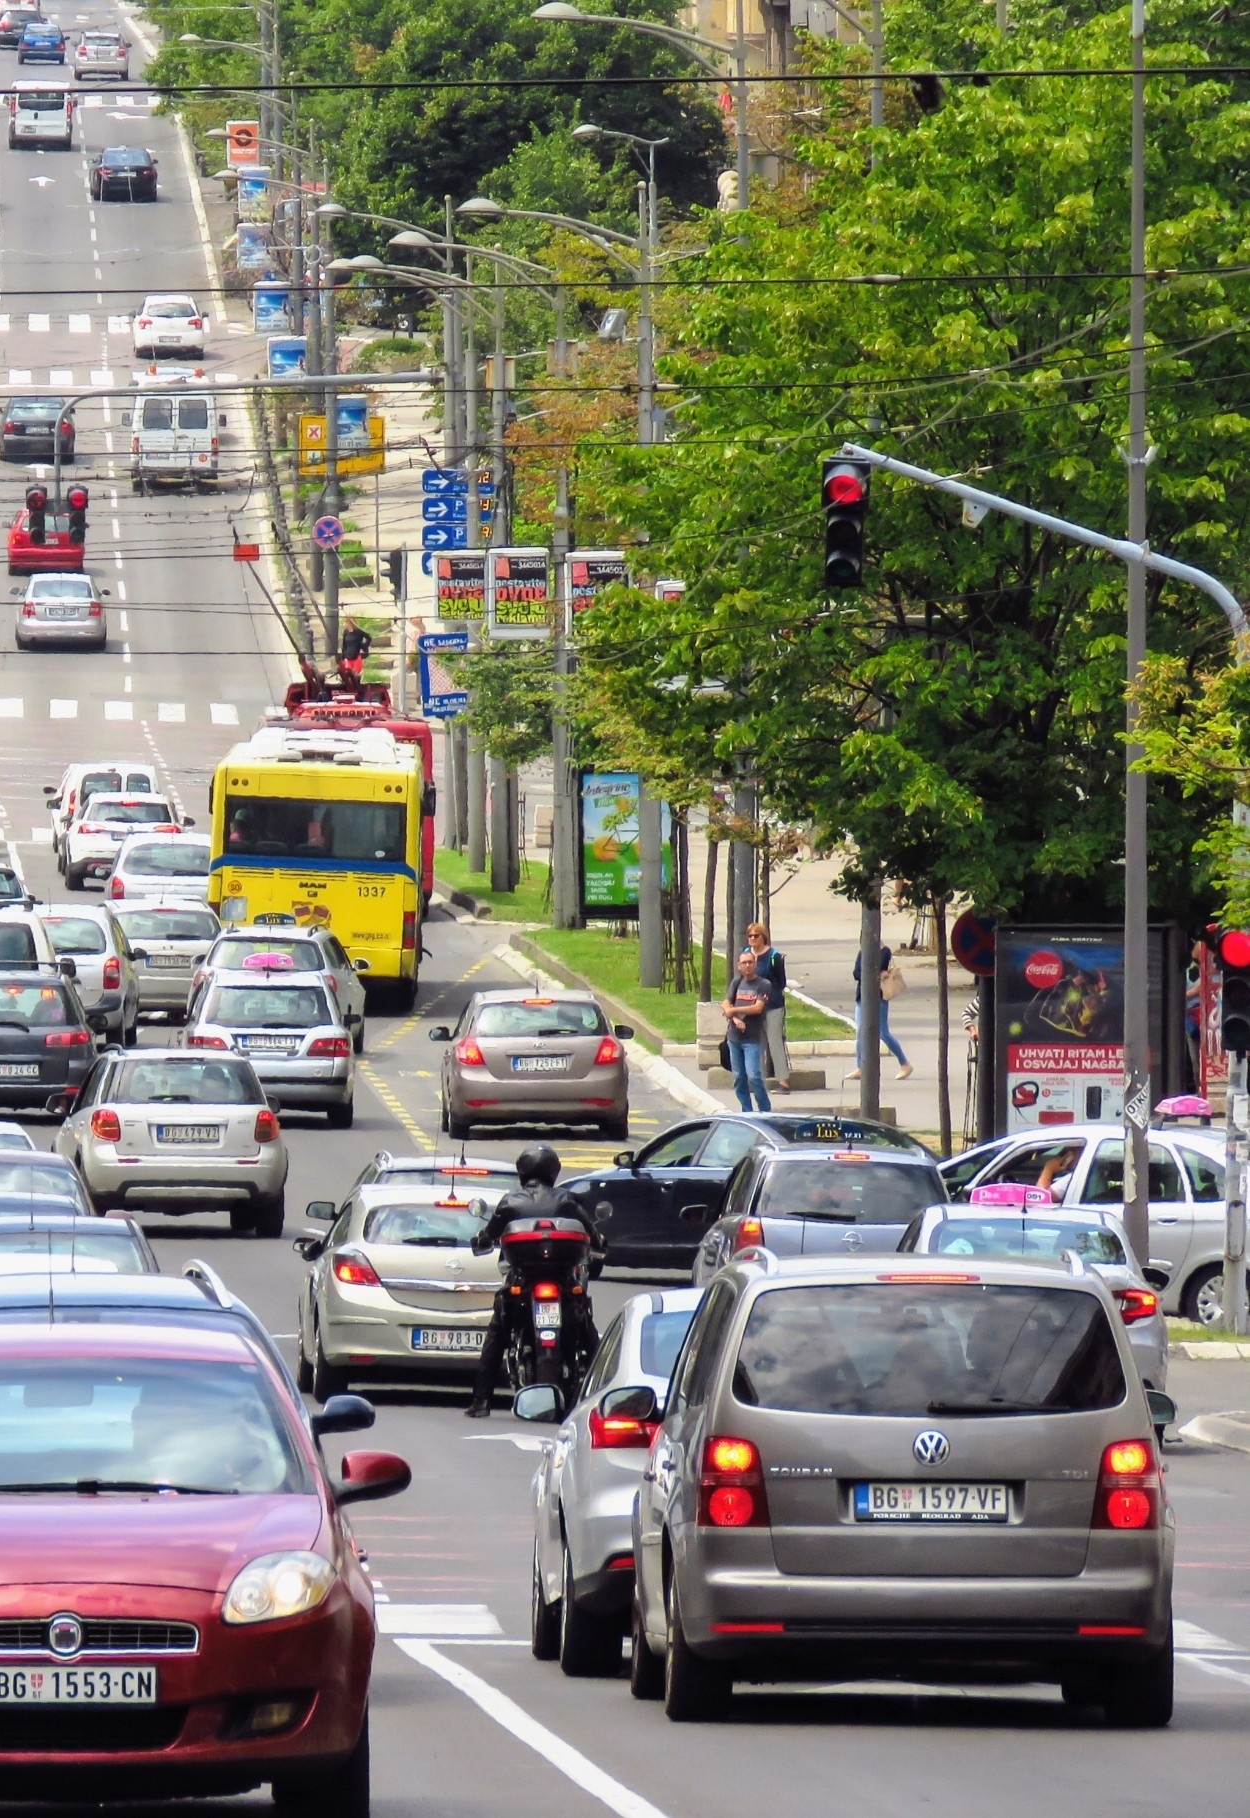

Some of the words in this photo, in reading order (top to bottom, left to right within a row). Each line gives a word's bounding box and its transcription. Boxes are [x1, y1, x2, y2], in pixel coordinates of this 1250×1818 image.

[456, 529, 464, 539] P
[357, 886, 386, 898] 1337
[1019, 1049, 1065, 1058] UHVATI
[1068, 1049, 1105, 1058] RITAM
[1109, 1049, 1124, 1058] LE
[1024, 1059, 1079, 1069] OSVAJAJ
[1082, 1060, 1124, 1069] NAGRA
[816, 1124, 839, 1138] Lux
[422, 1330, 437, 1344] BG
[448, 1330, 483, 1345] 983-D
[873, 1487, 898, 1509] BG
